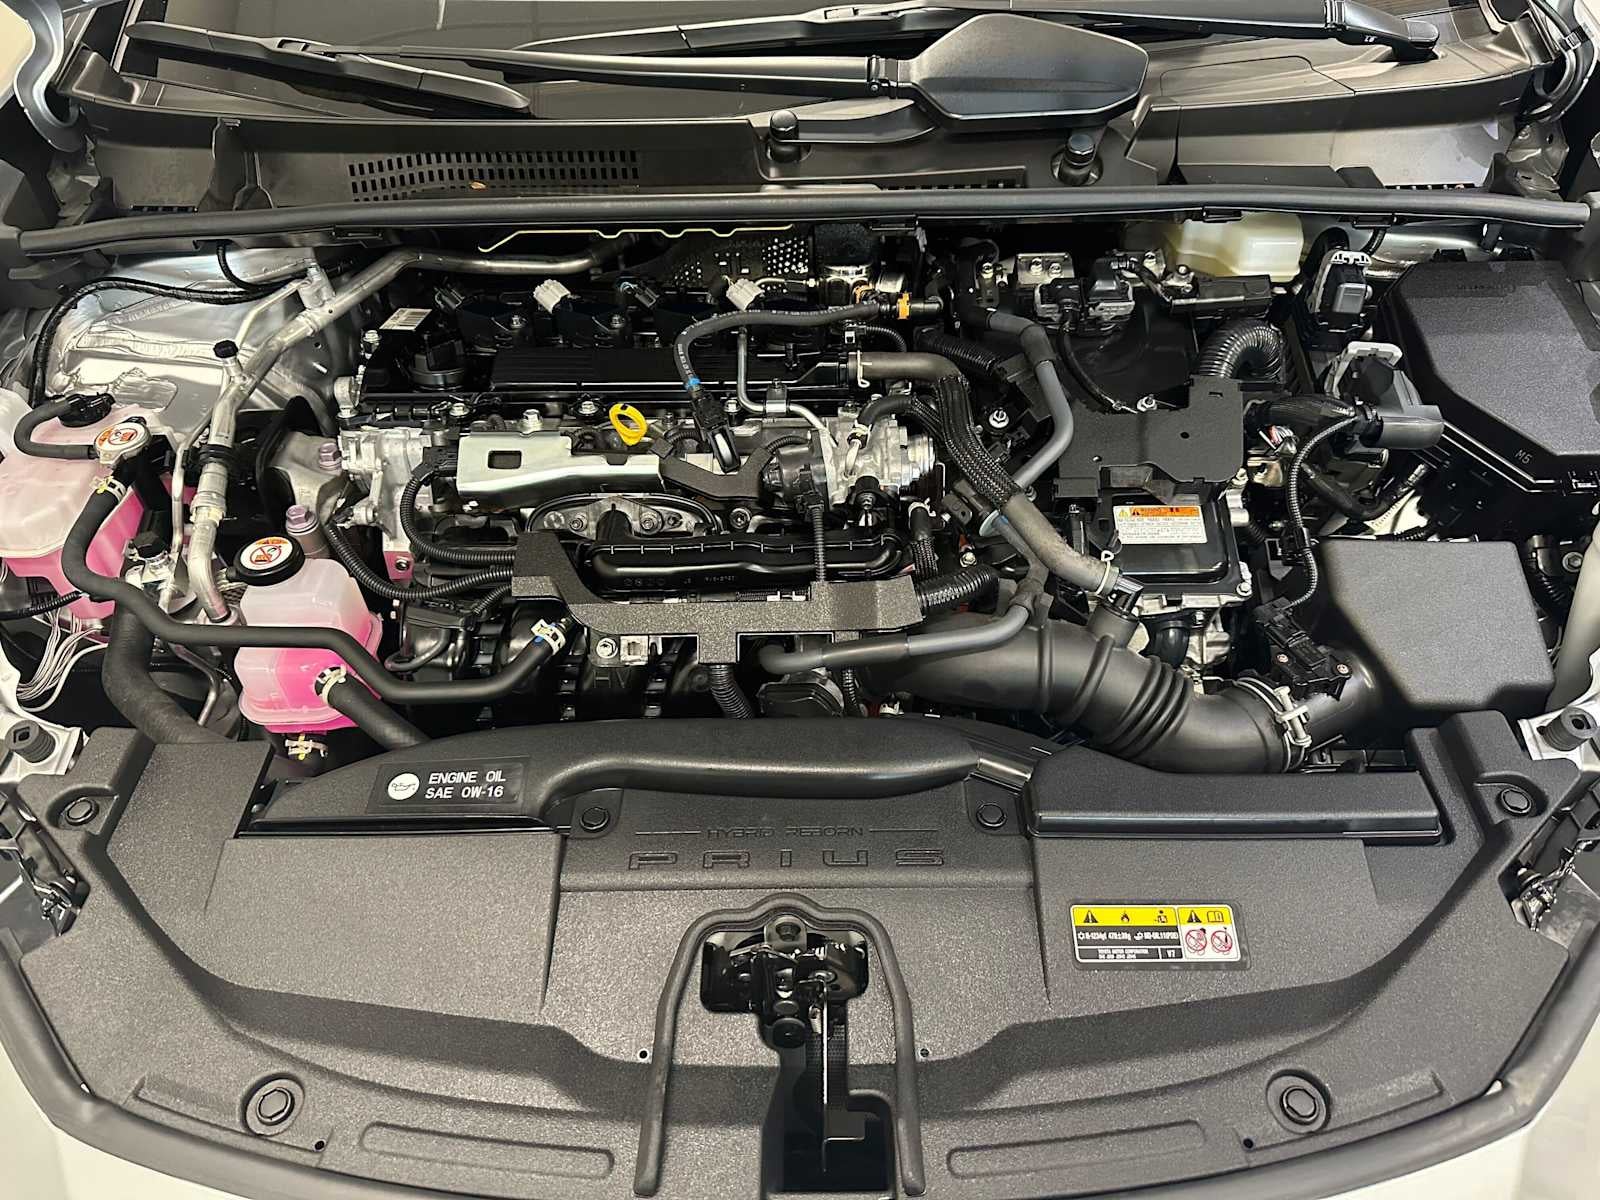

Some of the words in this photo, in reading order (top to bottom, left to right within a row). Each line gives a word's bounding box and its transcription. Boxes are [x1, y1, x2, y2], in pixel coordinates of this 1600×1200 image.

[428, 771, 478, 785] ENGINE
[485, 770, 507, 783] OIL
[425, 787, 453, 799] SAE
[461, 786, 504, 798] 0W-16
[707, 828, 775, 839] HYBRID
[784, 826, 864, 838] REBORN
[628, 848, 945, 870] PRIUS
